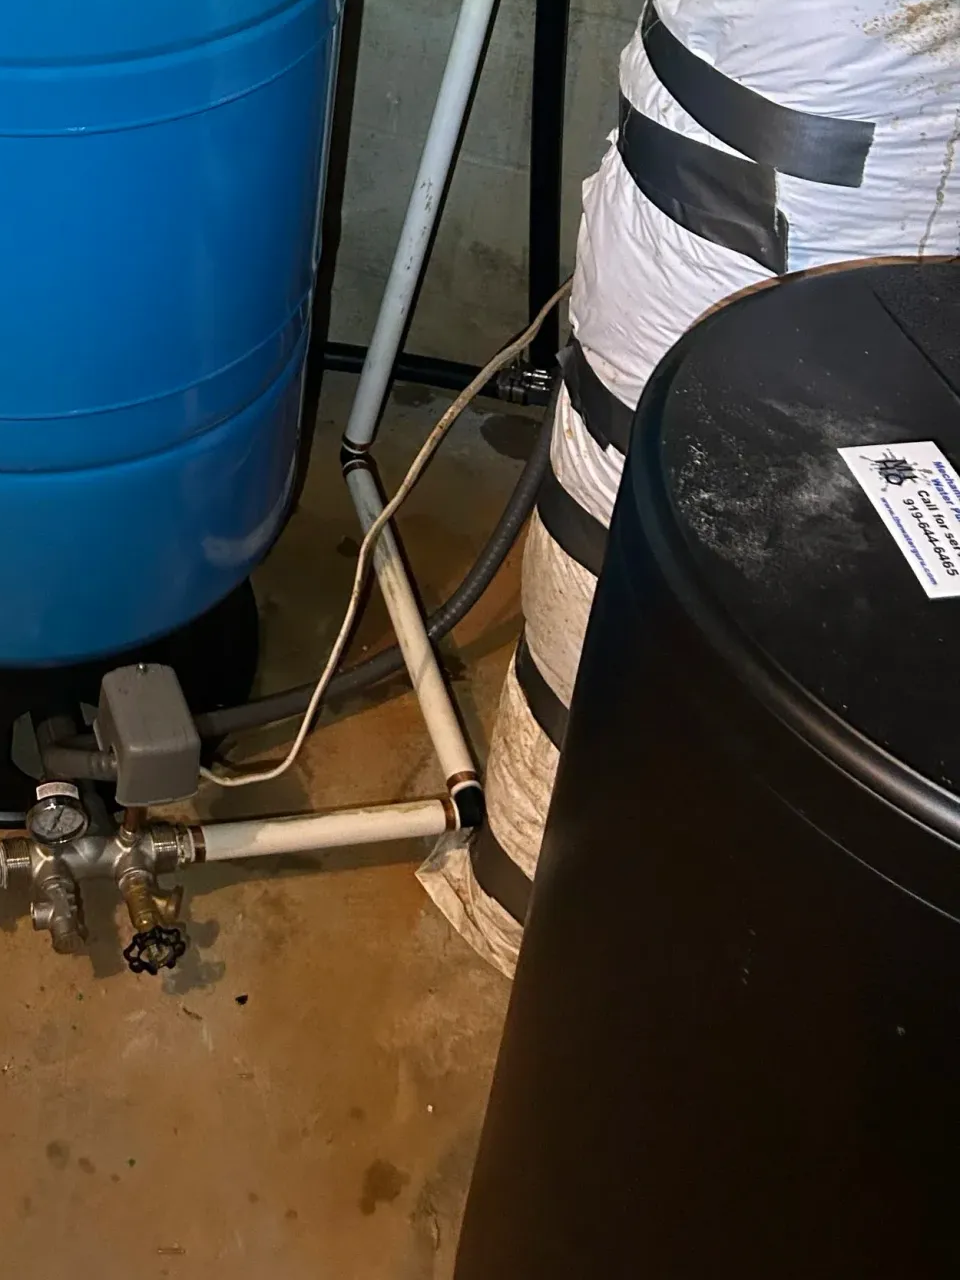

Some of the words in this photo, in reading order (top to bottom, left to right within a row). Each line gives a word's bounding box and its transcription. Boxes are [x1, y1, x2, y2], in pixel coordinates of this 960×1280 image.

[930, 478, 954, 510] Water
[932, 460, 960, 500] Mechan
[902, 498, 960, 577] 919-644-6465
[917, 489, 939, 512] Call
[932, 513, 950, 531] for
[944, 533, 960, 557] ser
